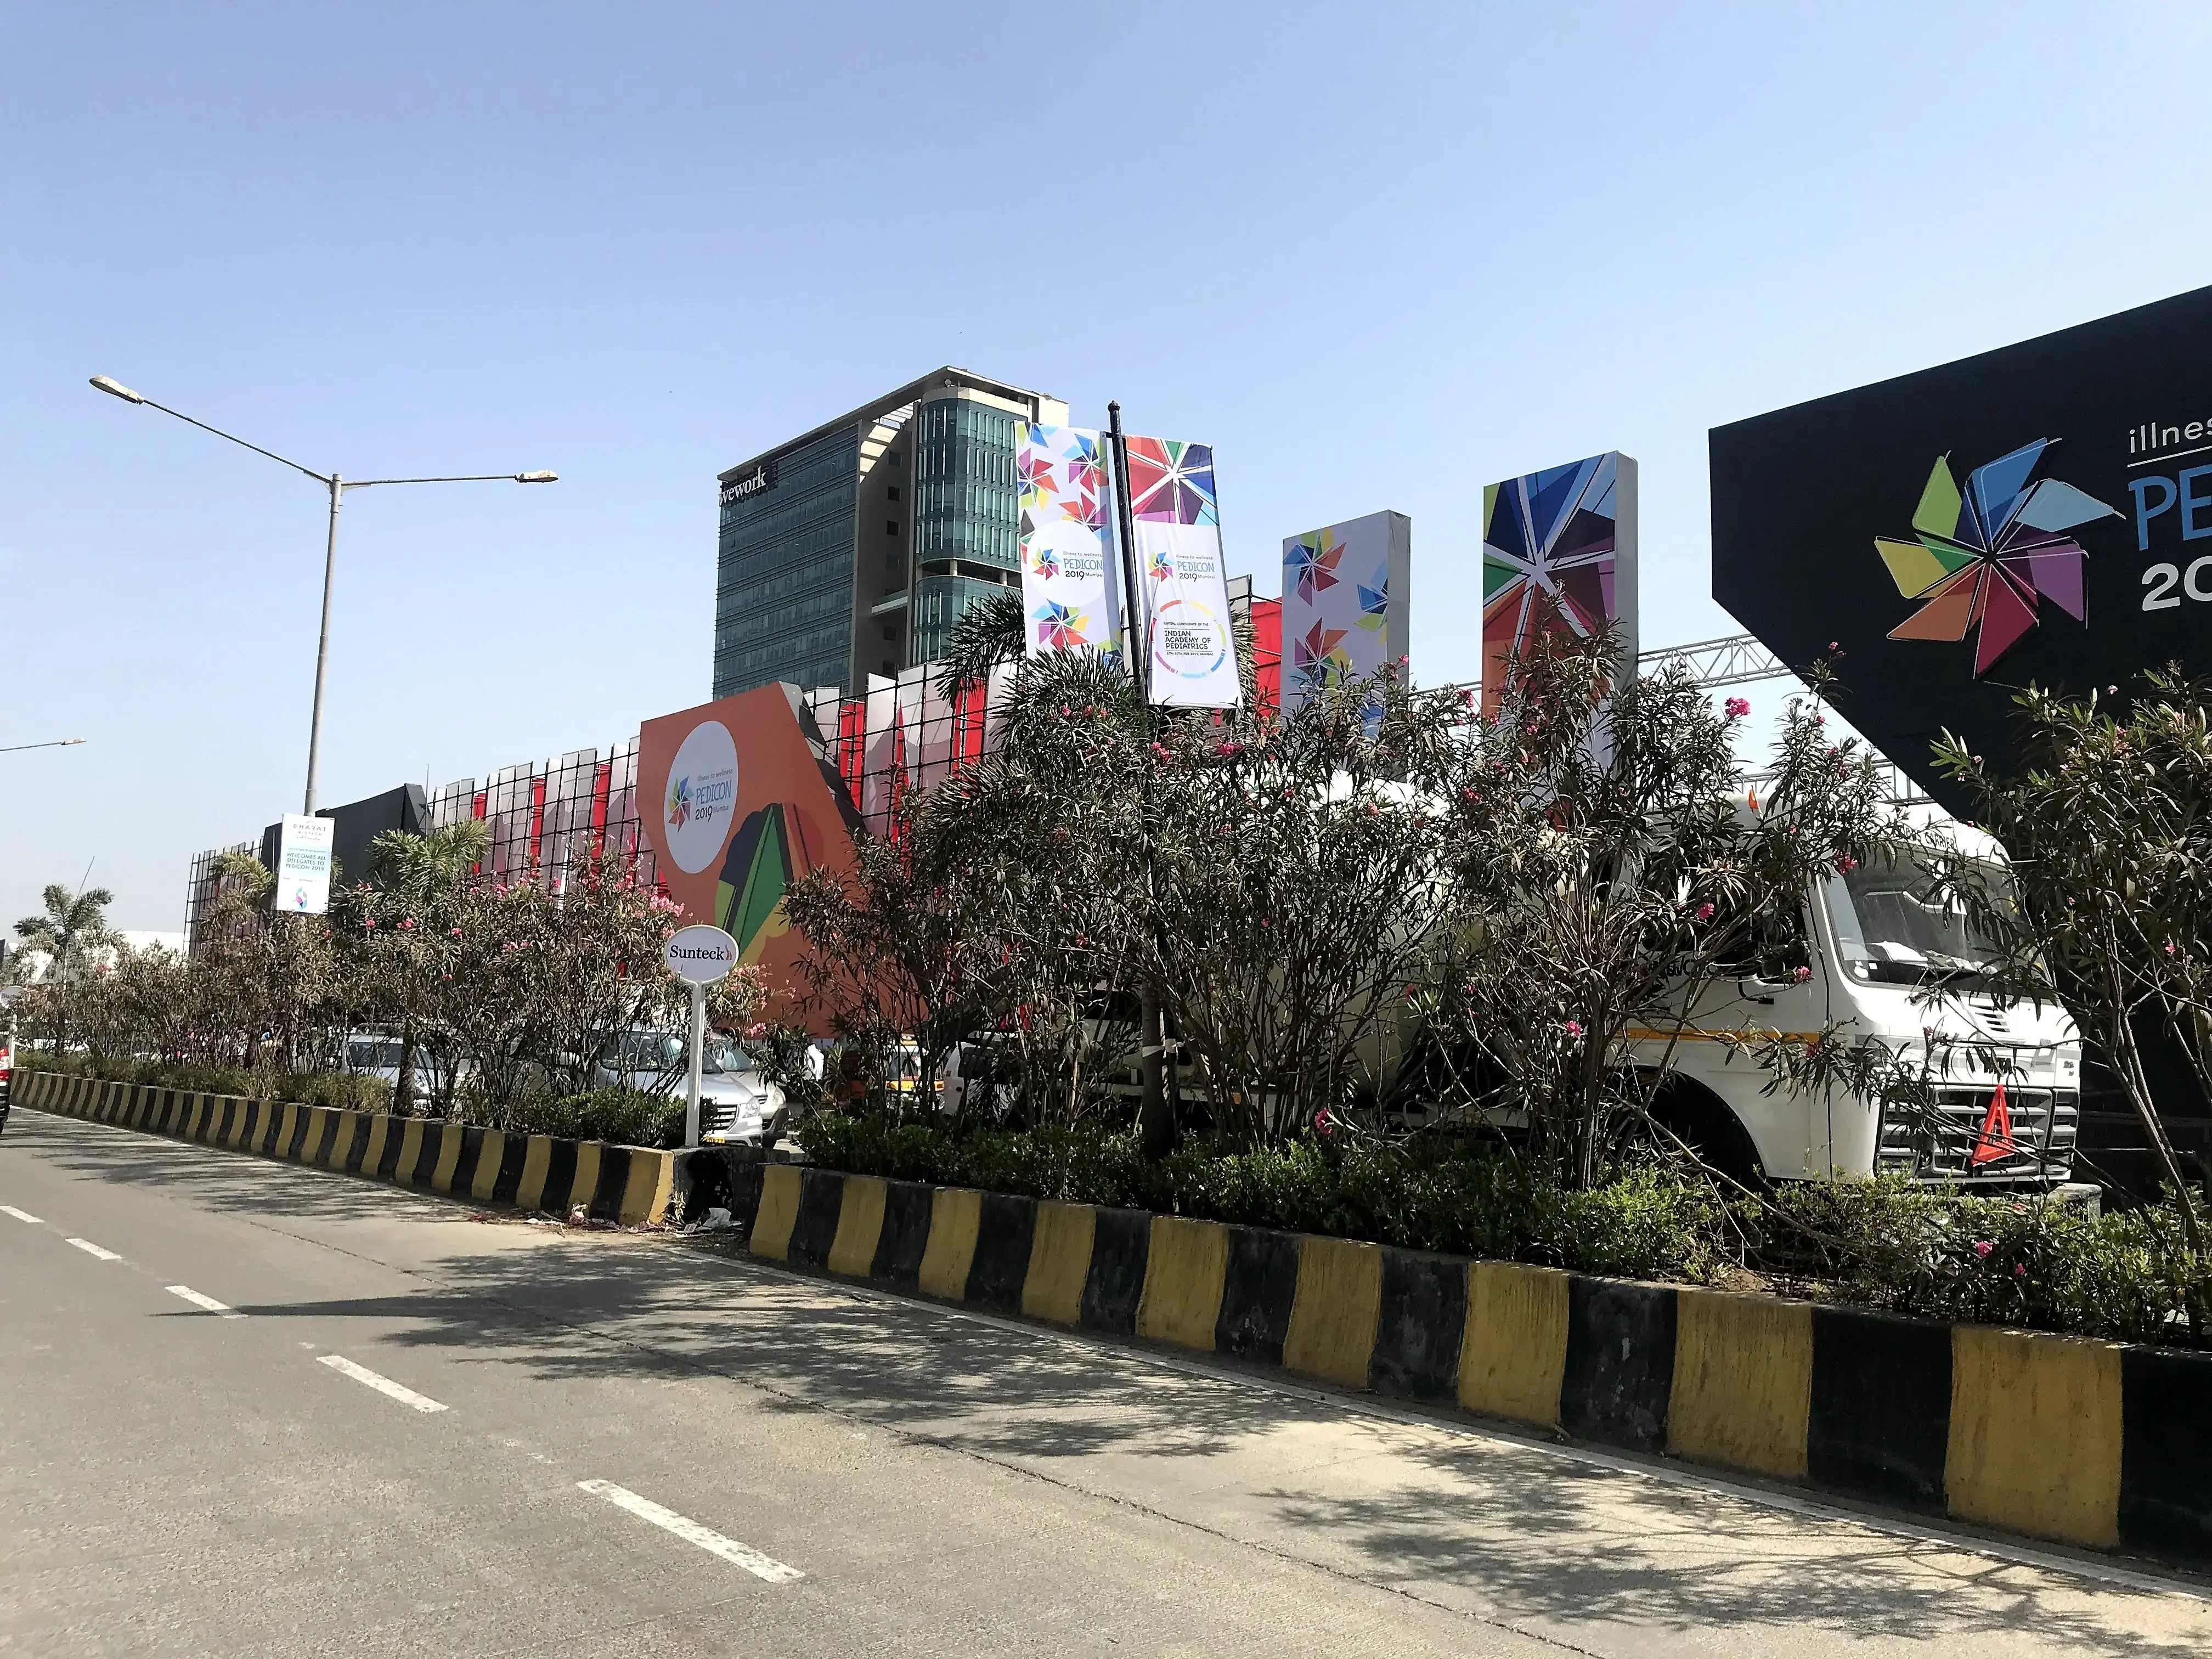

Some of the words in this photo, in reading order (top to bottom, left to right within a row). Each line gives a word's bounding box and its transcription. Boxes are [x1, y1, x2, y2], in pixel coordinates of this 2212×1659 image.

[719, 466, 766, 506] wework
[2128, 464, 2212, 551] PE
[1063, 558, 1103, 570] PEDICON
[1176, 561, 1215, 572] PEDICON
[1065, 570, 1085, 580] 2019
[1179, 572, 1197, 582] 2019
[696, 779, 732, 806] PEDICON
[695, 805, 713, 823] 2019
[669, 945, 725, 960] Sunteck
